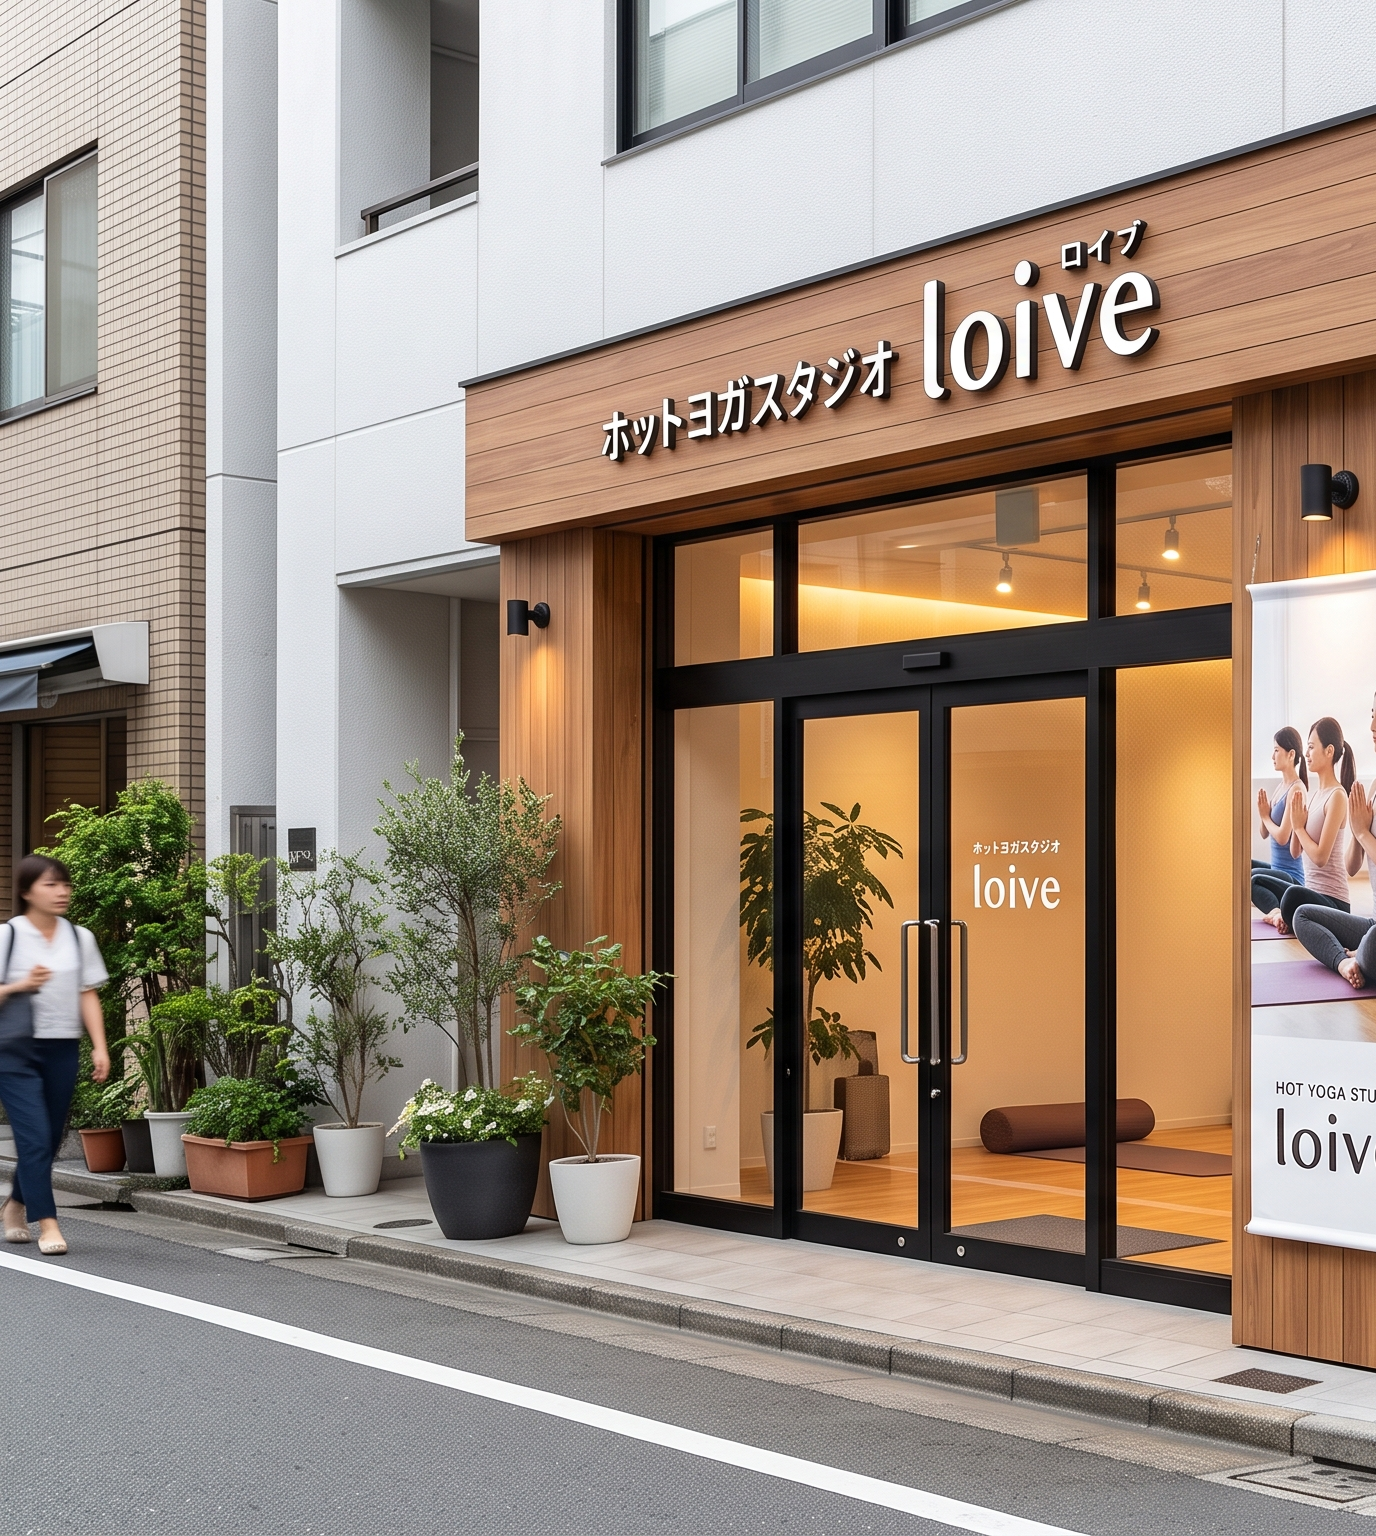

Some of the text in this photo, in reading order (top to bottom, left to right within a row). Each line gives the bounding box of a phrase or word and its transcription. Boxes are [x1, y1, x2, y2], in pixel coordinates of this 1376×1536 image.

[923, 259, 1161, 401] loive
[602, 340, 899, 462] ホットヨガスタジオ
[972, 839, 1061, 855] ホットヨガスタジオ
[973, 863, 1061, 910] loive
[1276, 1081, 1304, 1096] HOT
[1308, 1083, 1346, 1101] YOGA
